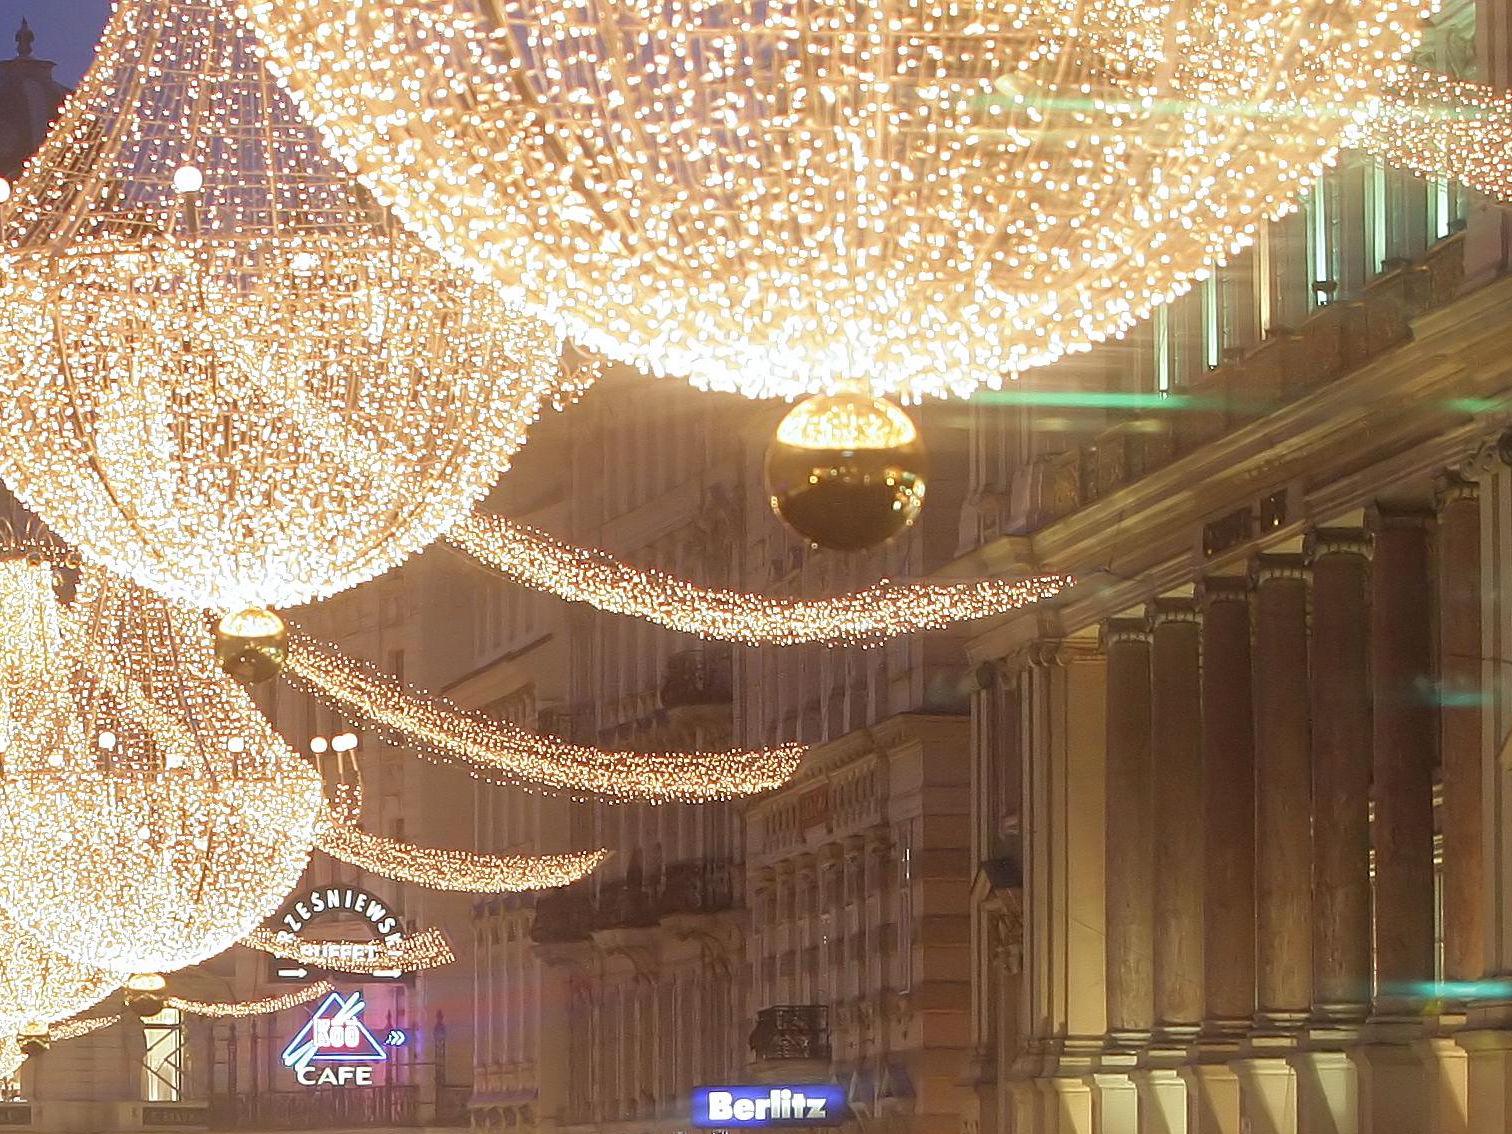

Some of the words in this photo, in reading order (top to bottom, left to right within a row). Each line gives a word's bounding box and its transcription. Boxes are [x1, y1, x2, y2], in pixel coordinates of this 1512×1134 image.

[275, 888, 404, 958] RZESNIEWSKI
[297, 1066, 373, 1086] CAFE
[709, 1089, 827, 1121] Berlitz
